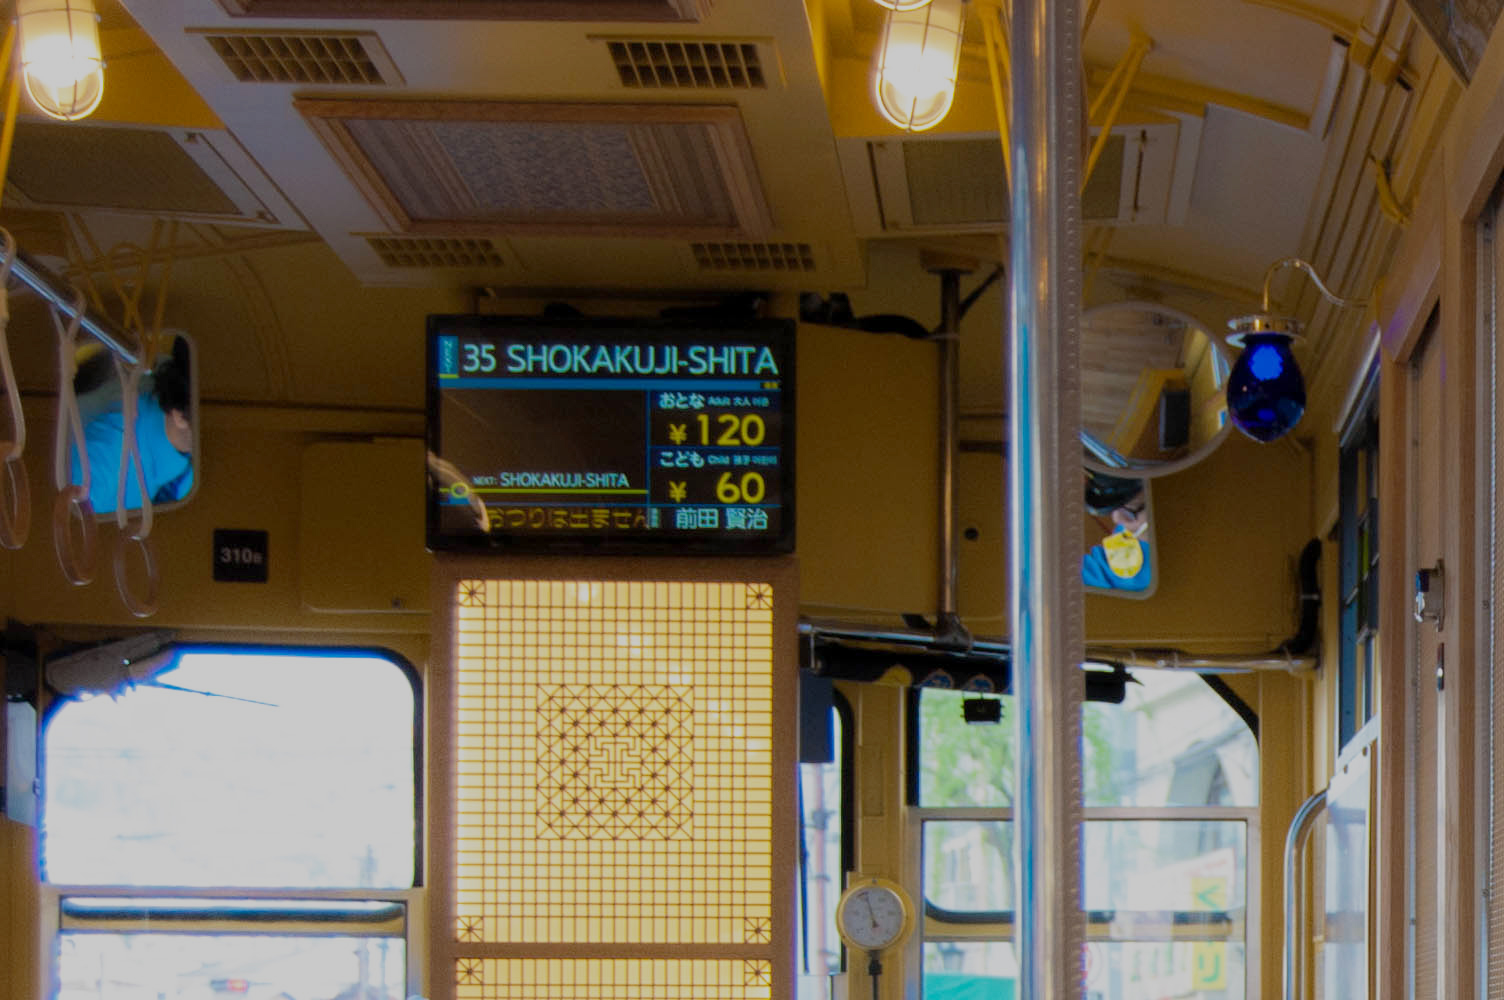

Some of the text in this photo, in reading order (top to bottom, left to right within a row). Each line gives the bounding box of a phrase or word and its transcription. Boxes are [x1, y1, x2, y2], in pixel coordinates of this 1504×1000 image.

[463, 344, 496, 373] 35
[507, 345, 780, 375] SHOKAKUJI-SHITA
[659, 392, 705, 409] おとな
[668, 413, 766, 446] ¥ 120
[659, 450, 705, 468] こども
[500, 472, 630, 488] SHOKAKUJI-SHITA
[668, 471, 766, 504] ¥ 60
[675, 506, 719, 530] 前田
